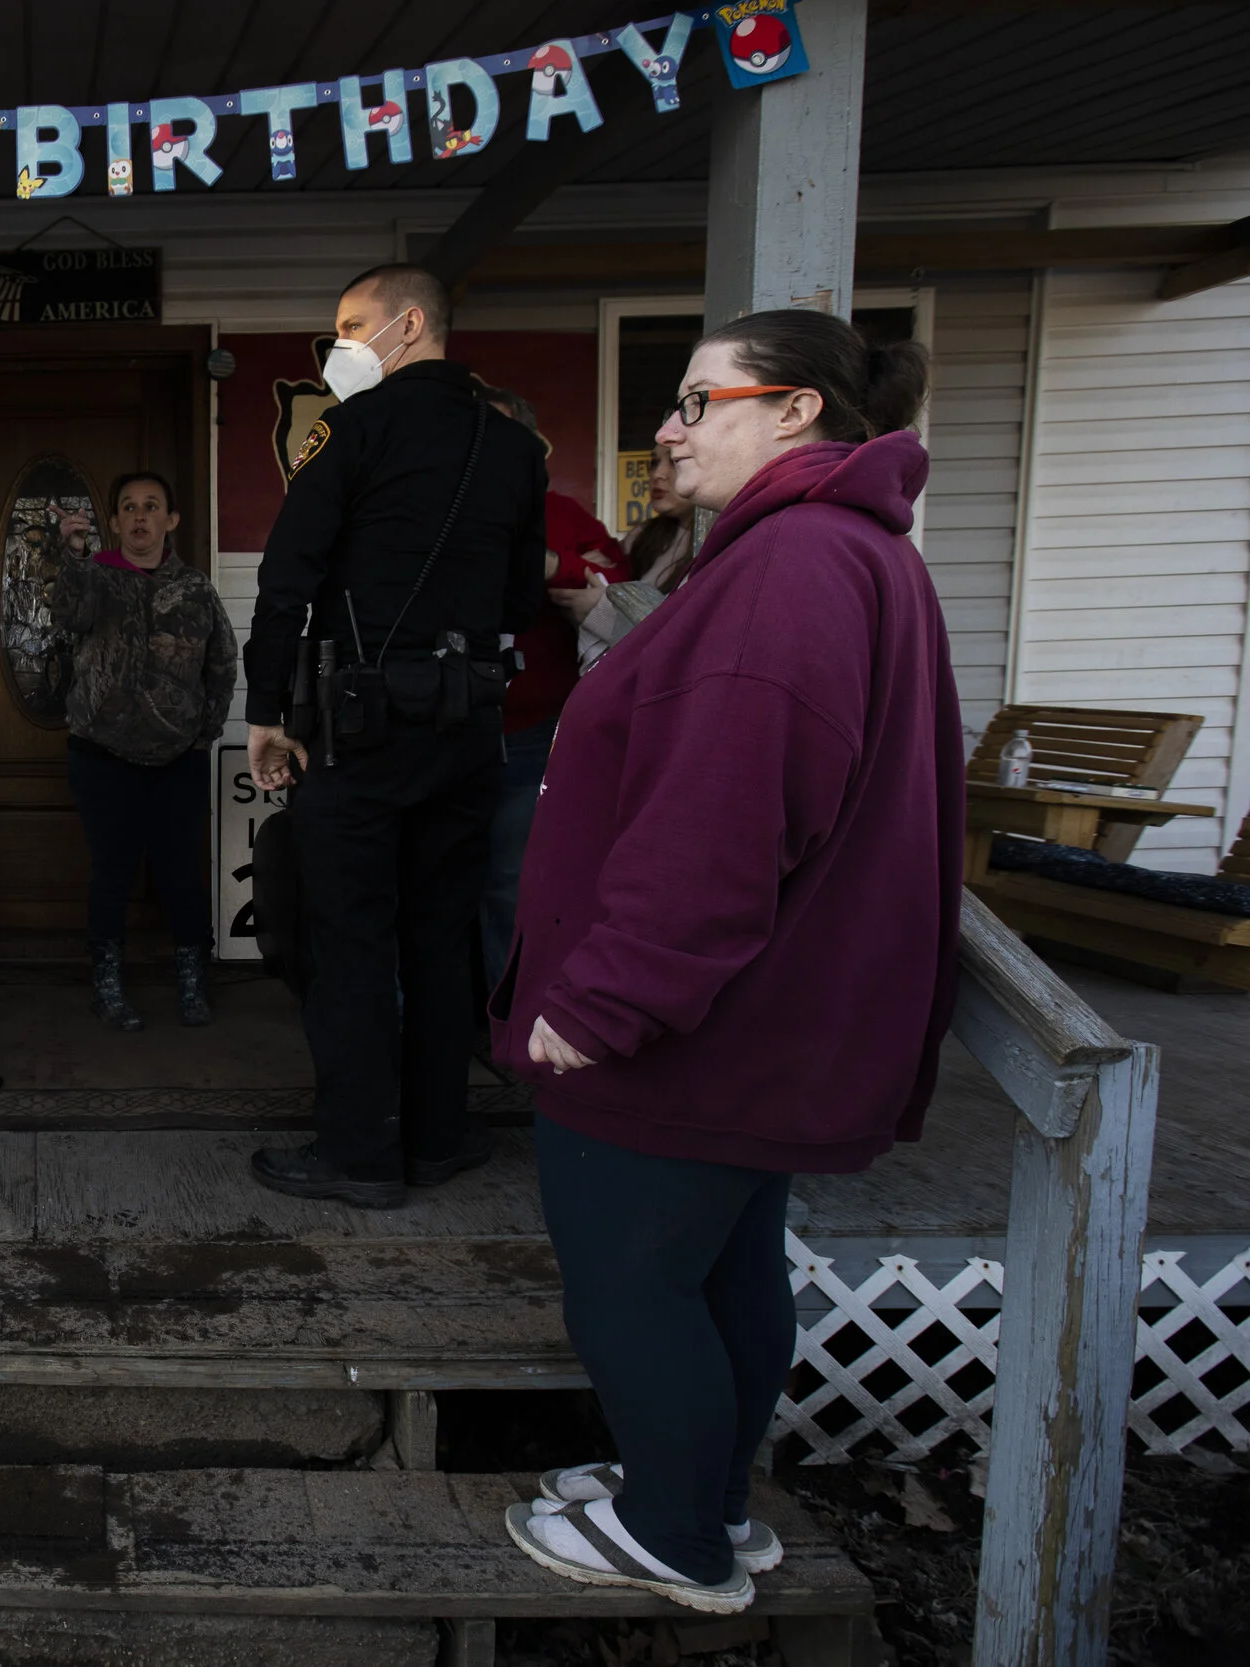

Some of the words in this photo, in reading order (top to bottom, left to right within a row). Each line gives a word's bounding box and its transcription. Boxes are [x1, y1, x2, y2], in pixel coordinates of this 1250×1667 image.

[15, 11, 695, 200] BIRTHDAY
[43, 252, 87, 271] GOD
[97, 250, 154, 269] BLESS
[40, 301, 155, 321] AMERICA
